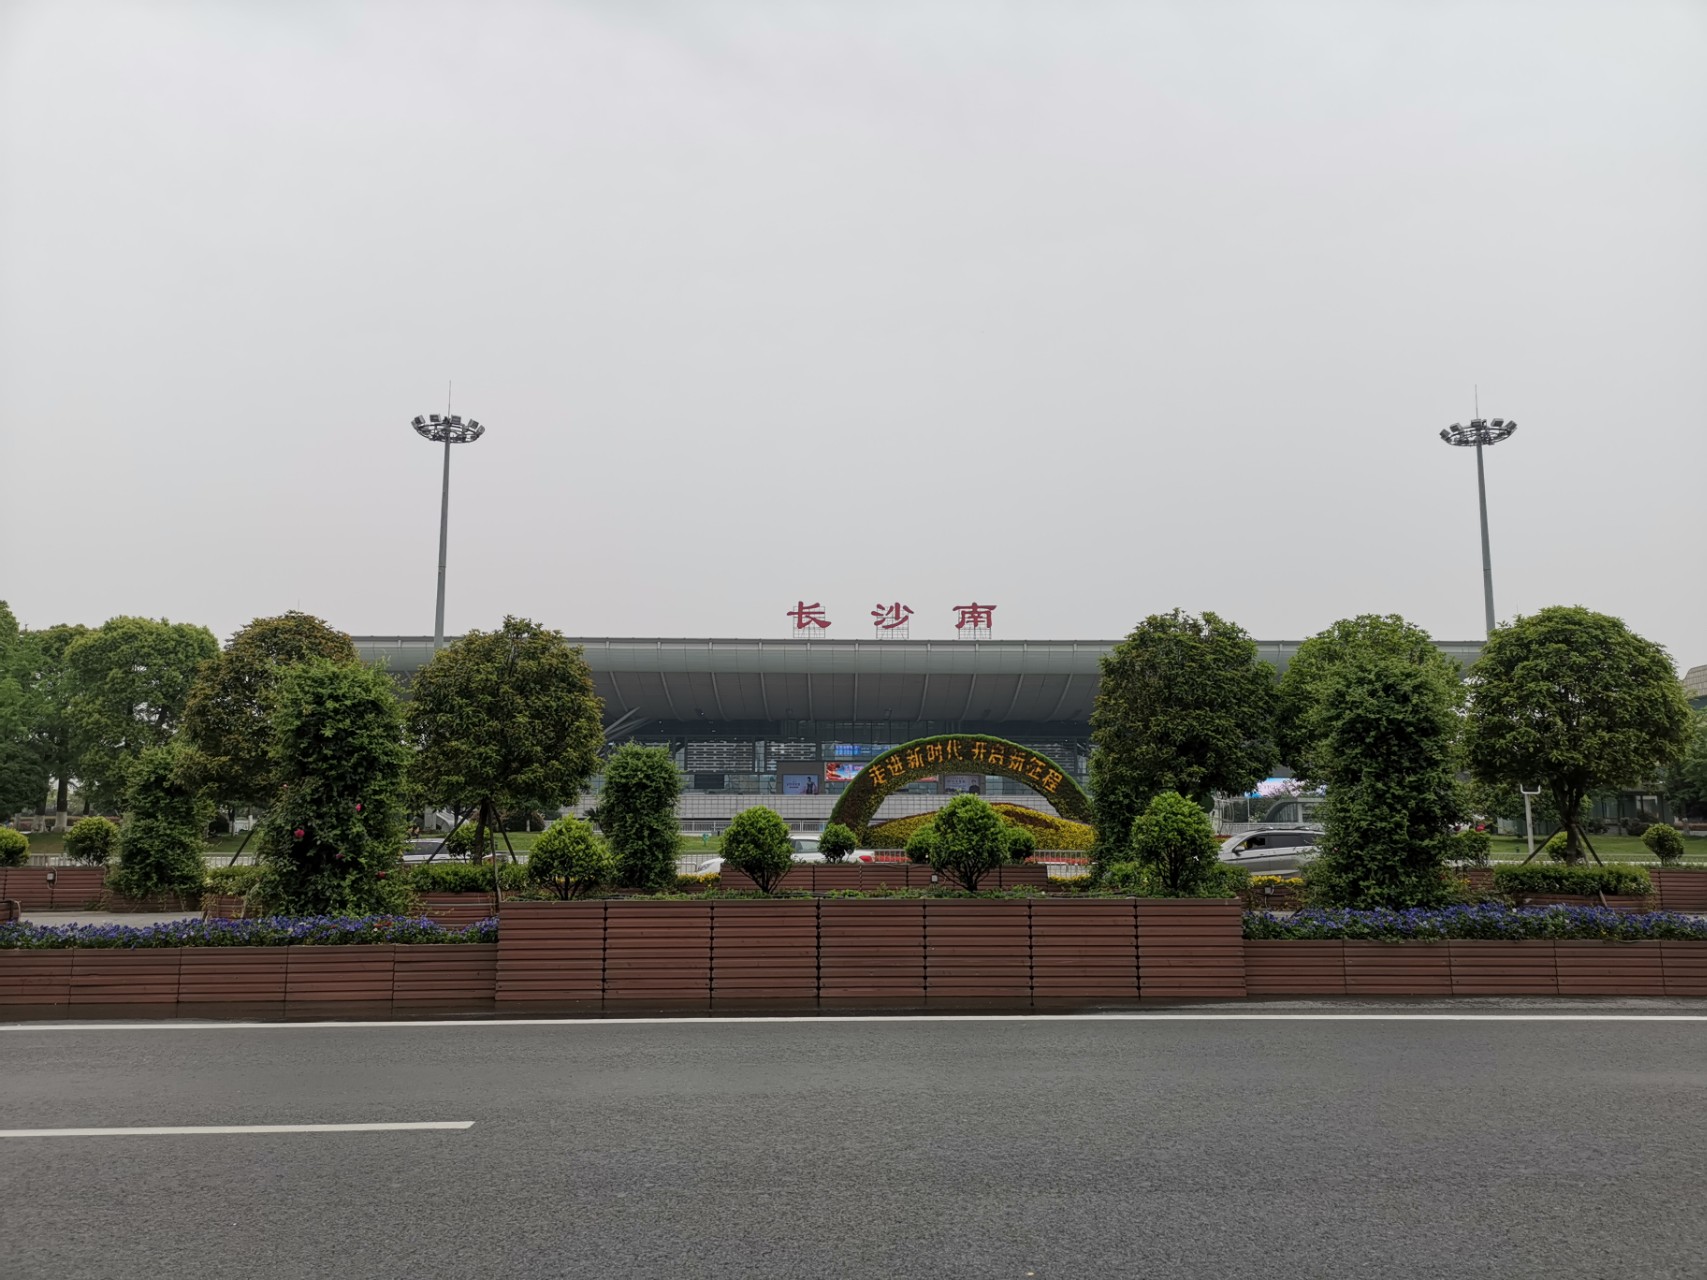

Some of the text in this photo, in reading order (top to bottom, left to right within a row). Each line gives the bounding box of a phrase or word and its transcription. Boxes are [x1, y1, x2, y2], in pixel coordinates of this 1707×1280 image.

[787, 601, 997, 629] 长沙南
[868, 740, 1063, 794] 走进新时代 开启新征程
